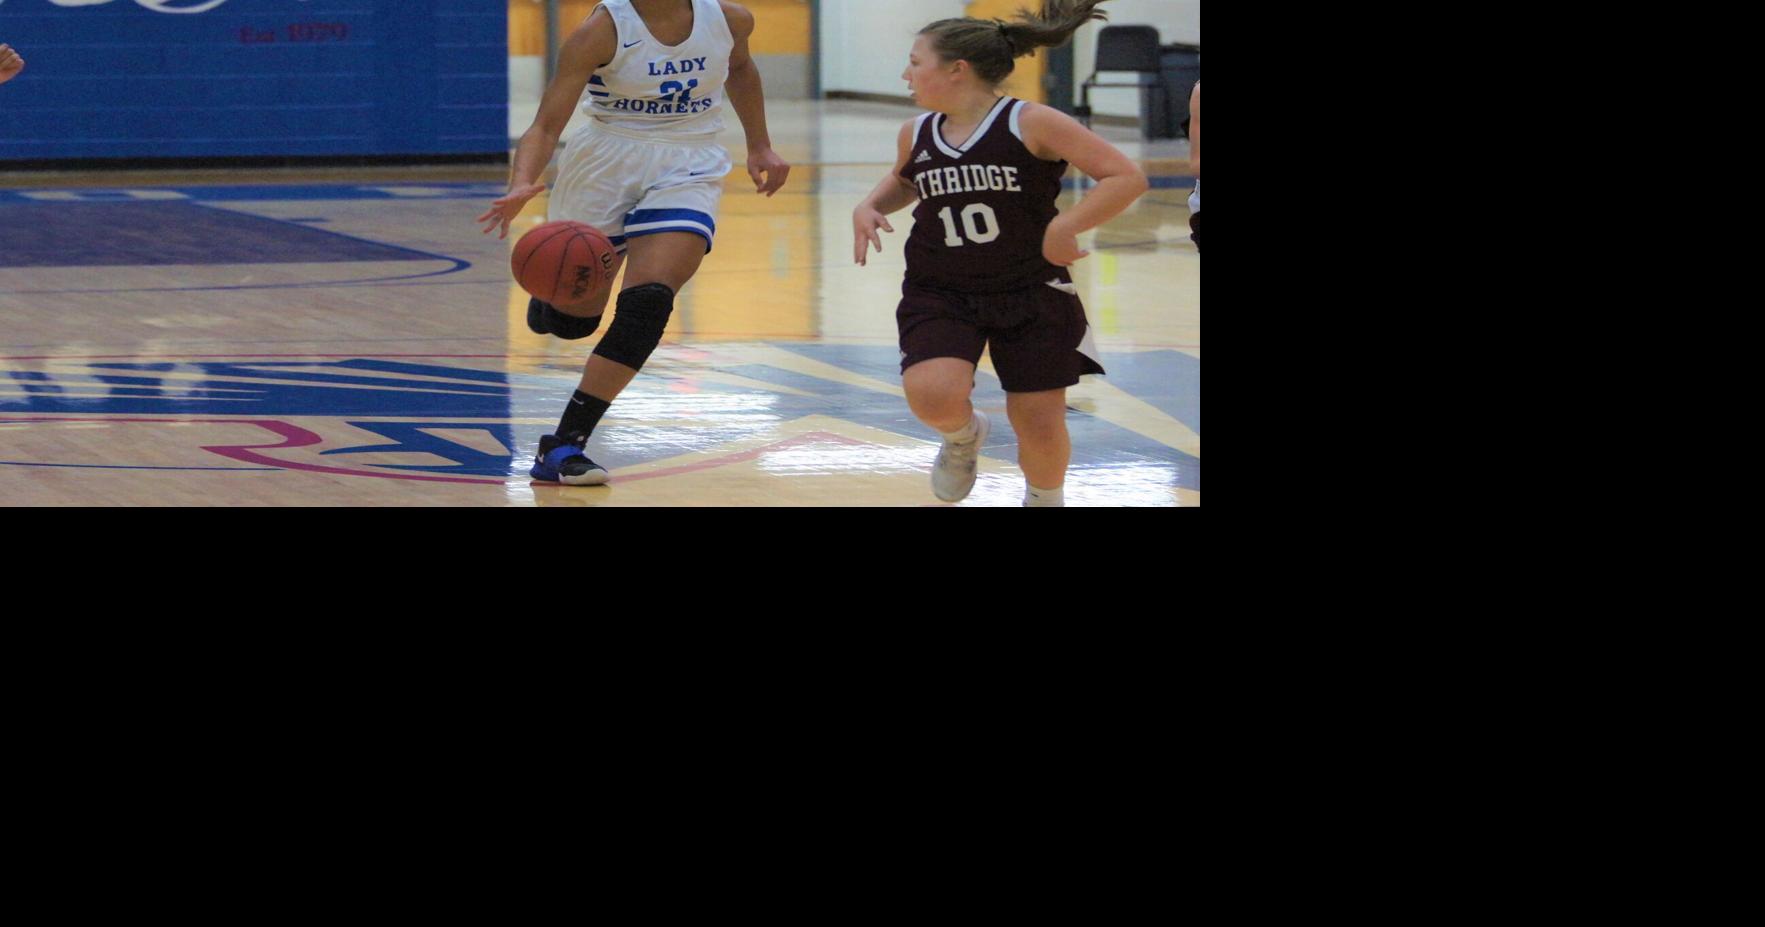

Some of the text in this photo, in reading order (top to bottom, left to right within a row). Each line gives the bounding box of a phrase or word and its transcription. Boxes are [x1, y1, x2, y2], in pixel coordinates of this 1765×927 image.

[648, 57, 706, 76] LADY
[613, 98, 712, 114] HORNETS
[937, 202, 1000, 247] 10
